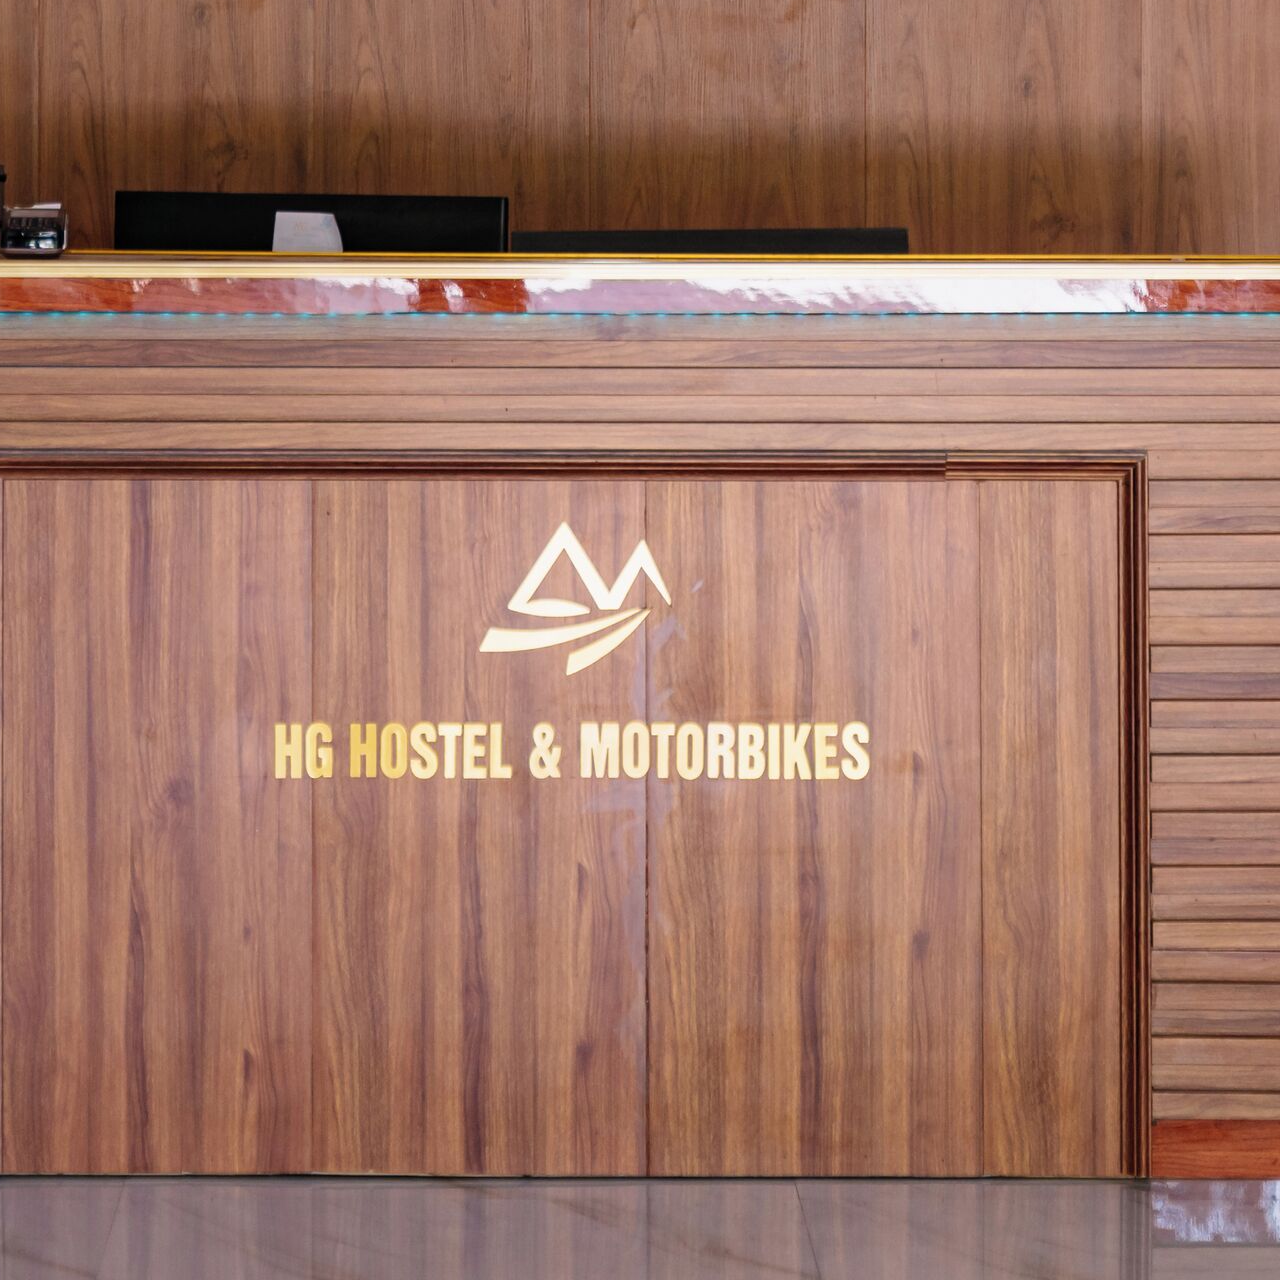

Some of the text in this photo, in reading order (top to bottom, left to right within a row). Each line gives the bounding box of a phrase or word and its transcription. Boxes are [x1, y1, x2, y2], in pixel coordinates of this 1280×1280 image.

[275, 722, 870, 781] HG HOSTEL & MOTORBIKES
